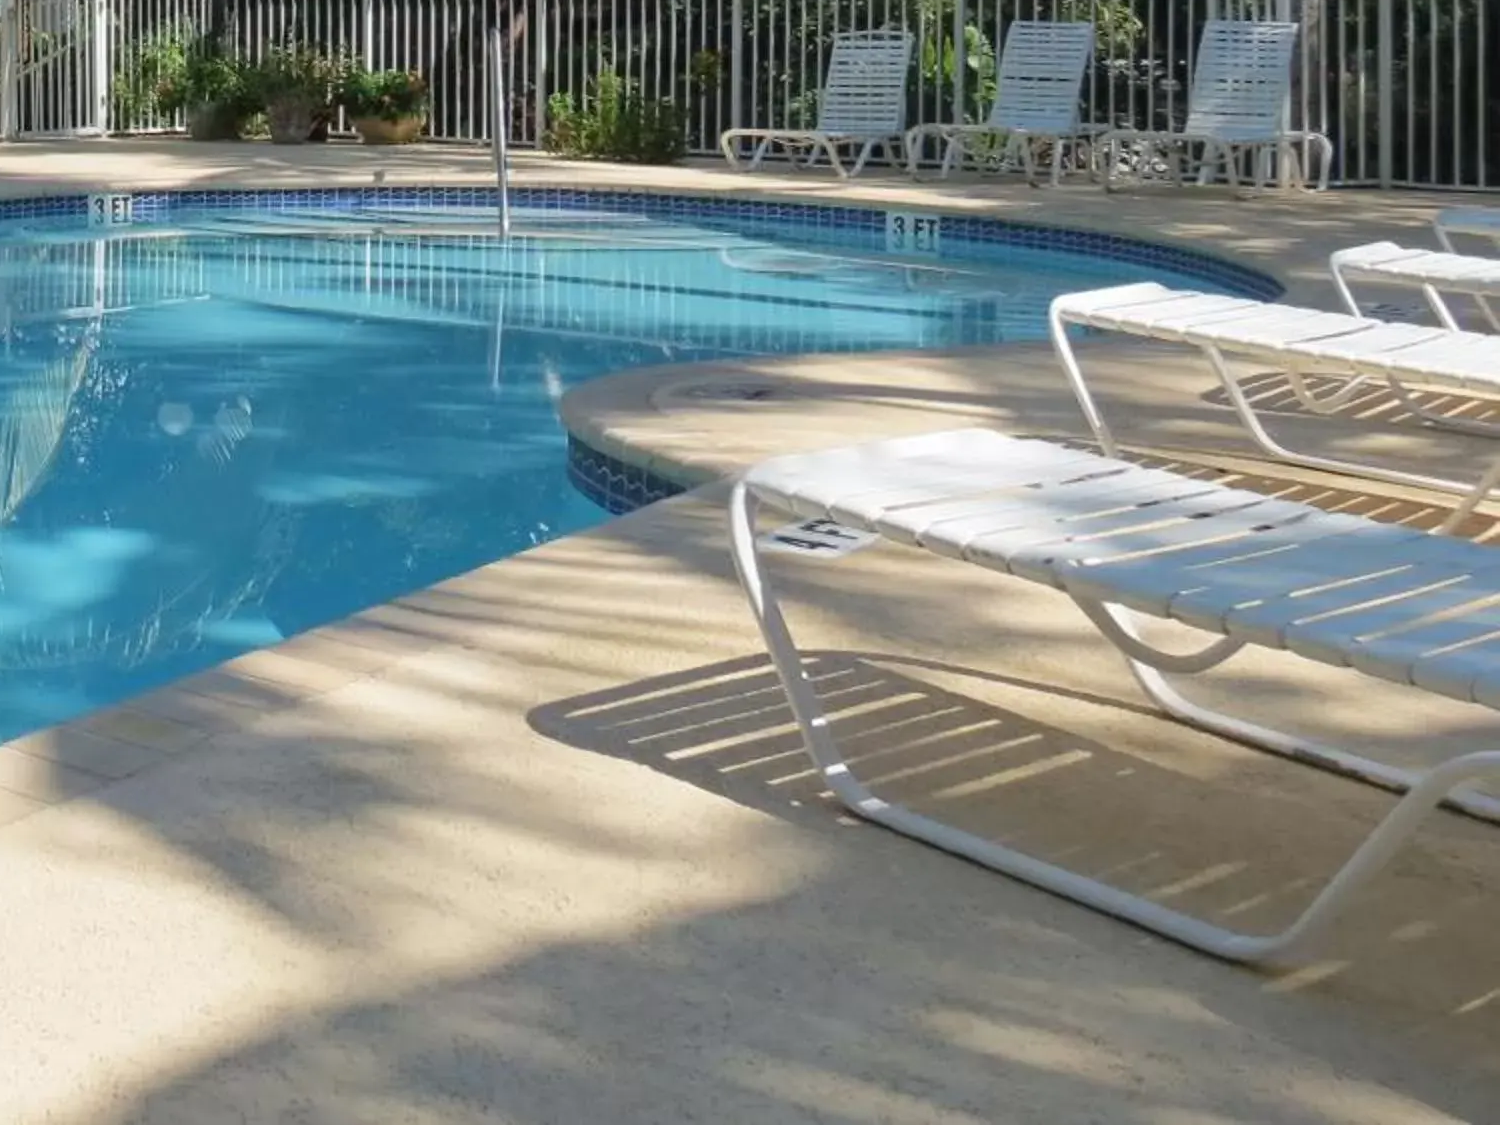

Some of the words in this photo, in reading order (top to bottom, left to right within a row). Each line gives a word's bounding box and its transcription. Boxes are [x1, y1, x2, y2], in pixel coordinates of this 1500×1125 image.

[94, 197, 105, 214] 3
[892, 216, 906, 236] 3
[914, 218, 938, 236] FT
[773, 534, 839, 550] 4
